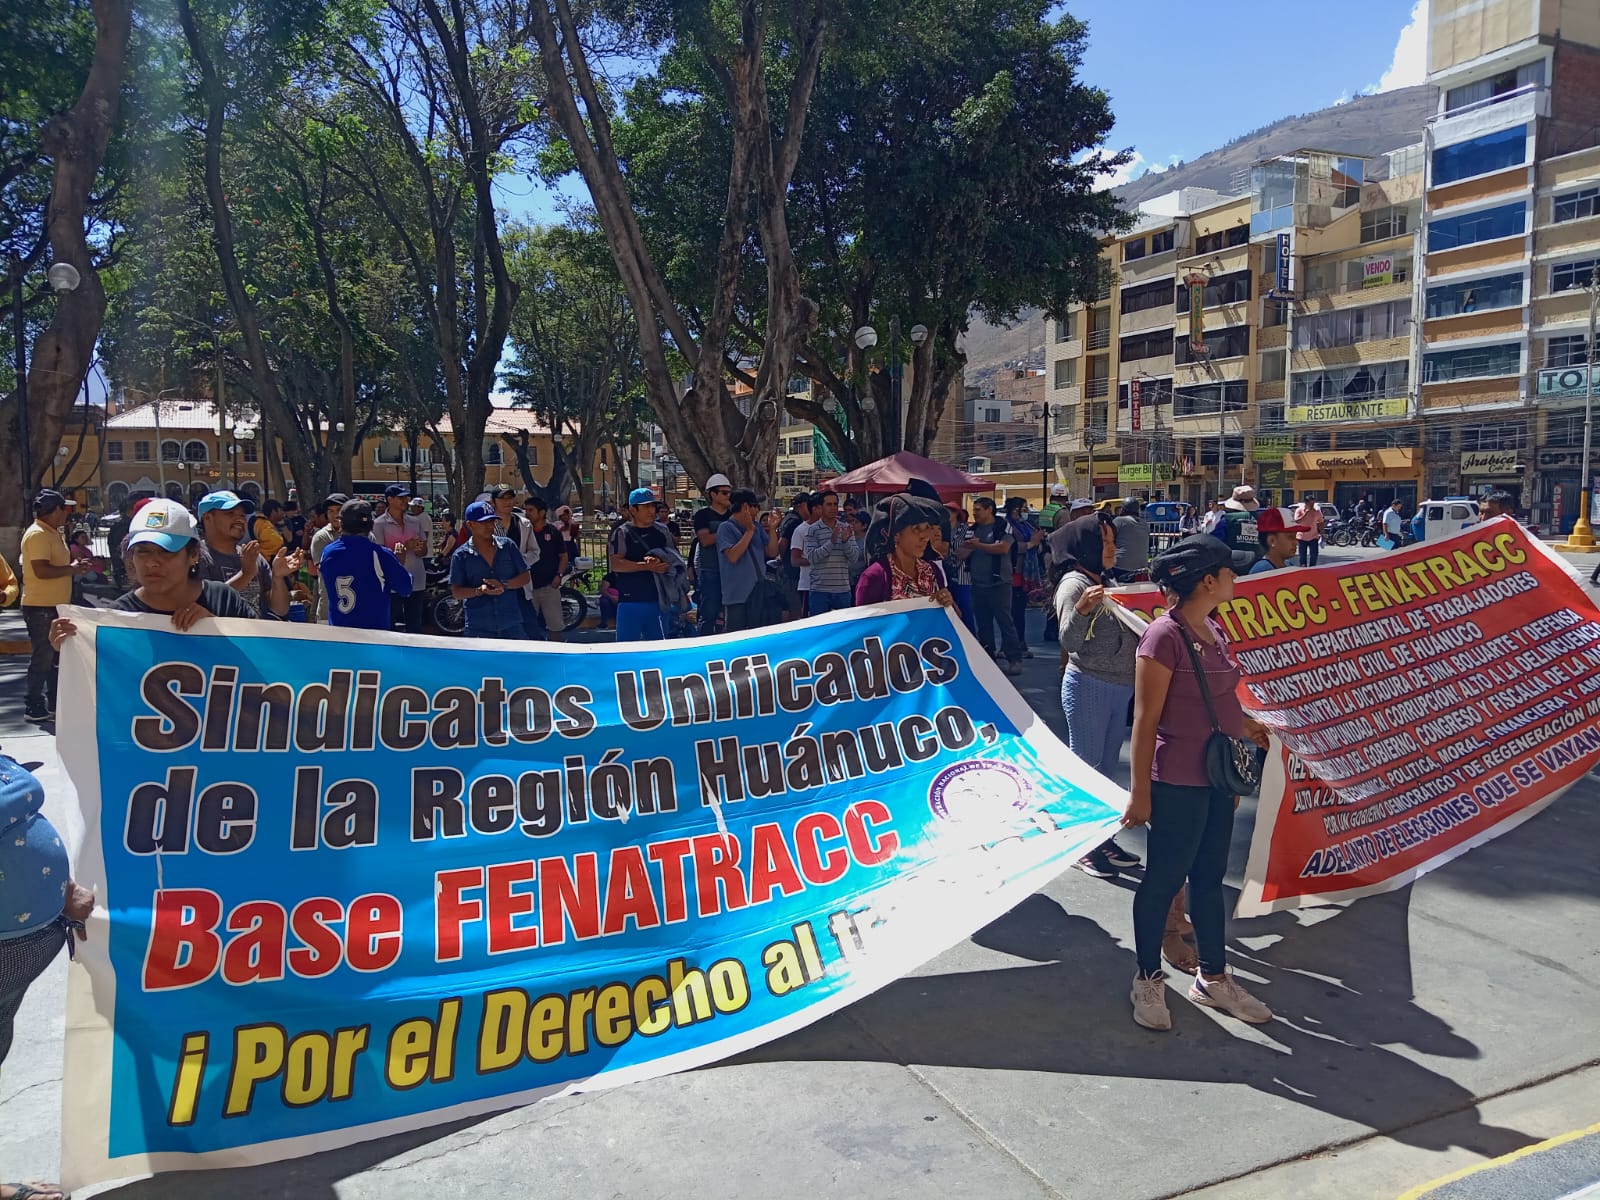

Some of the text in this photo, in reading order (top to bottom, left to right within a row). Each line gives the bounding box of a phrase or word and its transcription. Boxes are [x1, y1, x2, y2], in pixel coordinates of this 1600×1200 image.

[1281, 235, 1289, 289] HOTEL
[1366, 260, 1391, 276] VENDO
[1132, 382, 1140, 428] HOTEL
[1306, 402, 1384, 421] RESTAURANTE
[335, 576, 356, 614] 5
[1217, 583, 1328, 643] TRACC
[1338, 533, 1527, 616] FENATRACC
[1236, 571, 1539, 676] SINDICATO DEPARTAMENTAL DE TRABAJADORES
[131, 636, 960, 753] Sindicatos Unificados
[1263, 656, 1362, 705] CONSTRUCCIÓN
[1358, 650, 1397, 677] CIVIL
[1390, 644, 1417, 667] DE
[1409, 620, 1484, 661] HUÁNUCO
[1298, 696, 1343, 725] CONTRA
[1336, 692, 1358, 714] LA
[1350, 674, 1414, 710] DICTADURA
[1406, 668, 1430, 689] DE
[1422, 660, 1458, 683] DINA
[1450, 632, 1520, 674] BOLUARTE
[1510, 628, 1530, 646] Y
[1521, 607, 1585, 641] DEFENSA
[1457, 672, 1494, 699] ALTO
[1487, 667, 1506, 685] A
[1496, 661, 1523, 681] LA
[1362, 731, 1424, 768] GOBIERNO,
[1414, 705, 1483, 747] CONGRESO
[1475, 699, 1494, 718] Y
[1487, 674, 1553, 716] FISCALÍA
[1542, 665, 1572, 686] DE
[1561, 656, 1590, 677] LA
[1370, 711, 1391, 733] NI
[1436, 735, 1493, 767] MORAL,
[1484, 695, 1571, 741] FINANCIERA
[1562, 687, 1579, 700] Y
[123, 705, 998, 856] de la Región Huánuco,
[938, 764, 970, 787] NACIONAL
[1299, 833, 1379, 879] ADELANTO
[1370, 825, 1400, 858] DE
[1391, 792, 1481, 852] ELECCIONES
[1473, 772, 1520, 808] QUE
[1510, 757, 1546, 788] SE
[1535, 724, 1600, 773] VAYAN
[1323, 814, 1341, 836] POR
[1336, 811, 1352, 832] UN
[1349, 802, 1387, 828] GOBIERNO
[1383, 776, 1457, 816] DEMOCRÁTICO
[1451, 768, 1467, 783] Y
[1463, 760, 1486, 779] DE
[1482, 707, 1586, 770] REGENERACIÓN
[141, 888, 403, 993] Base
[434, 800, 900, 963] FENATRACC
[221, 1021, 370, 1120] Por
[384, 996, 464, 1091] el
[477, 957, 750, 1077] Derecho
[762, 921, 828, 997] al
